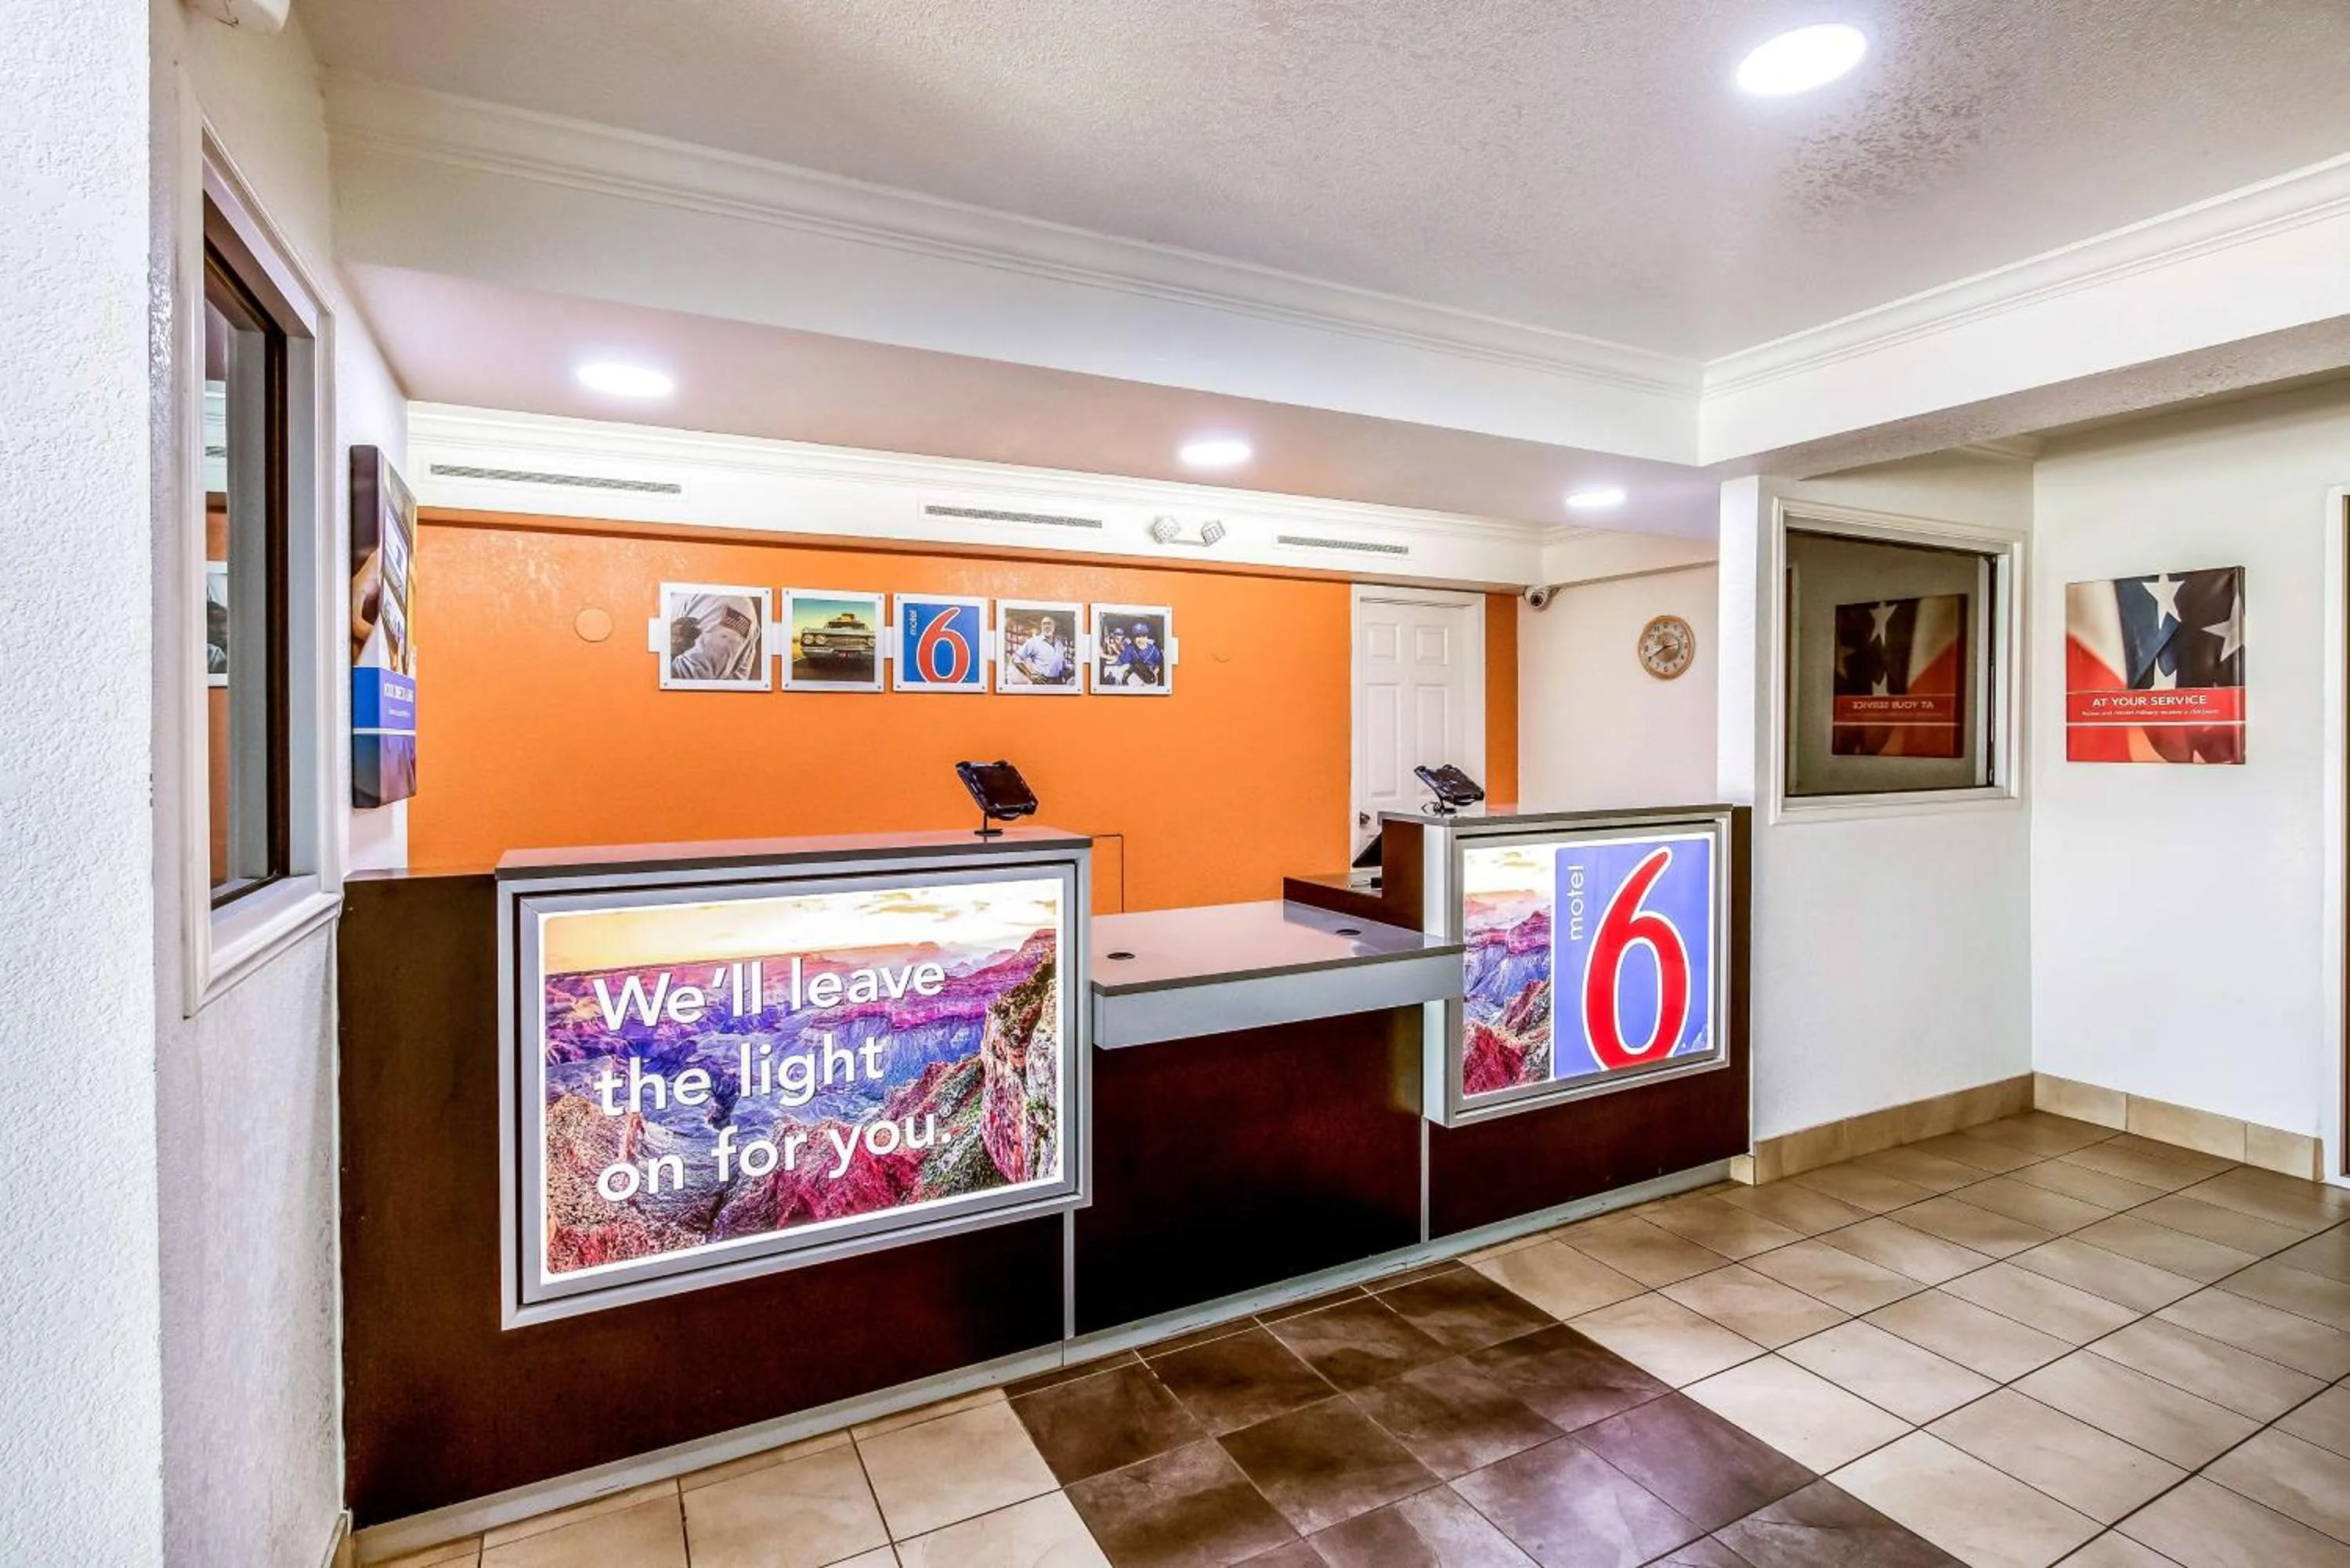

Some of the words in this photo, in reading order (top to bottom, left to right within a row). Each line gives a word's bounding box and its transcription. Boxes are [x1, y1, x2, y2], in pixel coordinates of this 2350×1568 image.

[916, 607, 971, 684] 6
[2092, 697, 2107, 707] AT
[2111, 695, 2147, 706] YOUR
[2150, 695, 2207, 706] SERVICE
[593, 963, 764, 1031] We'll
[791, 957, 945, 1012] leave
[1566, 865, 1585, 941] motel
[1582, 846, 1691, 1071] 6
[594, 1057, 711, 1117] the
[739, 1035, 885, 1107] light
[596, 1155, 685, 1203] on
[710, 1124, 808, 1183] for
